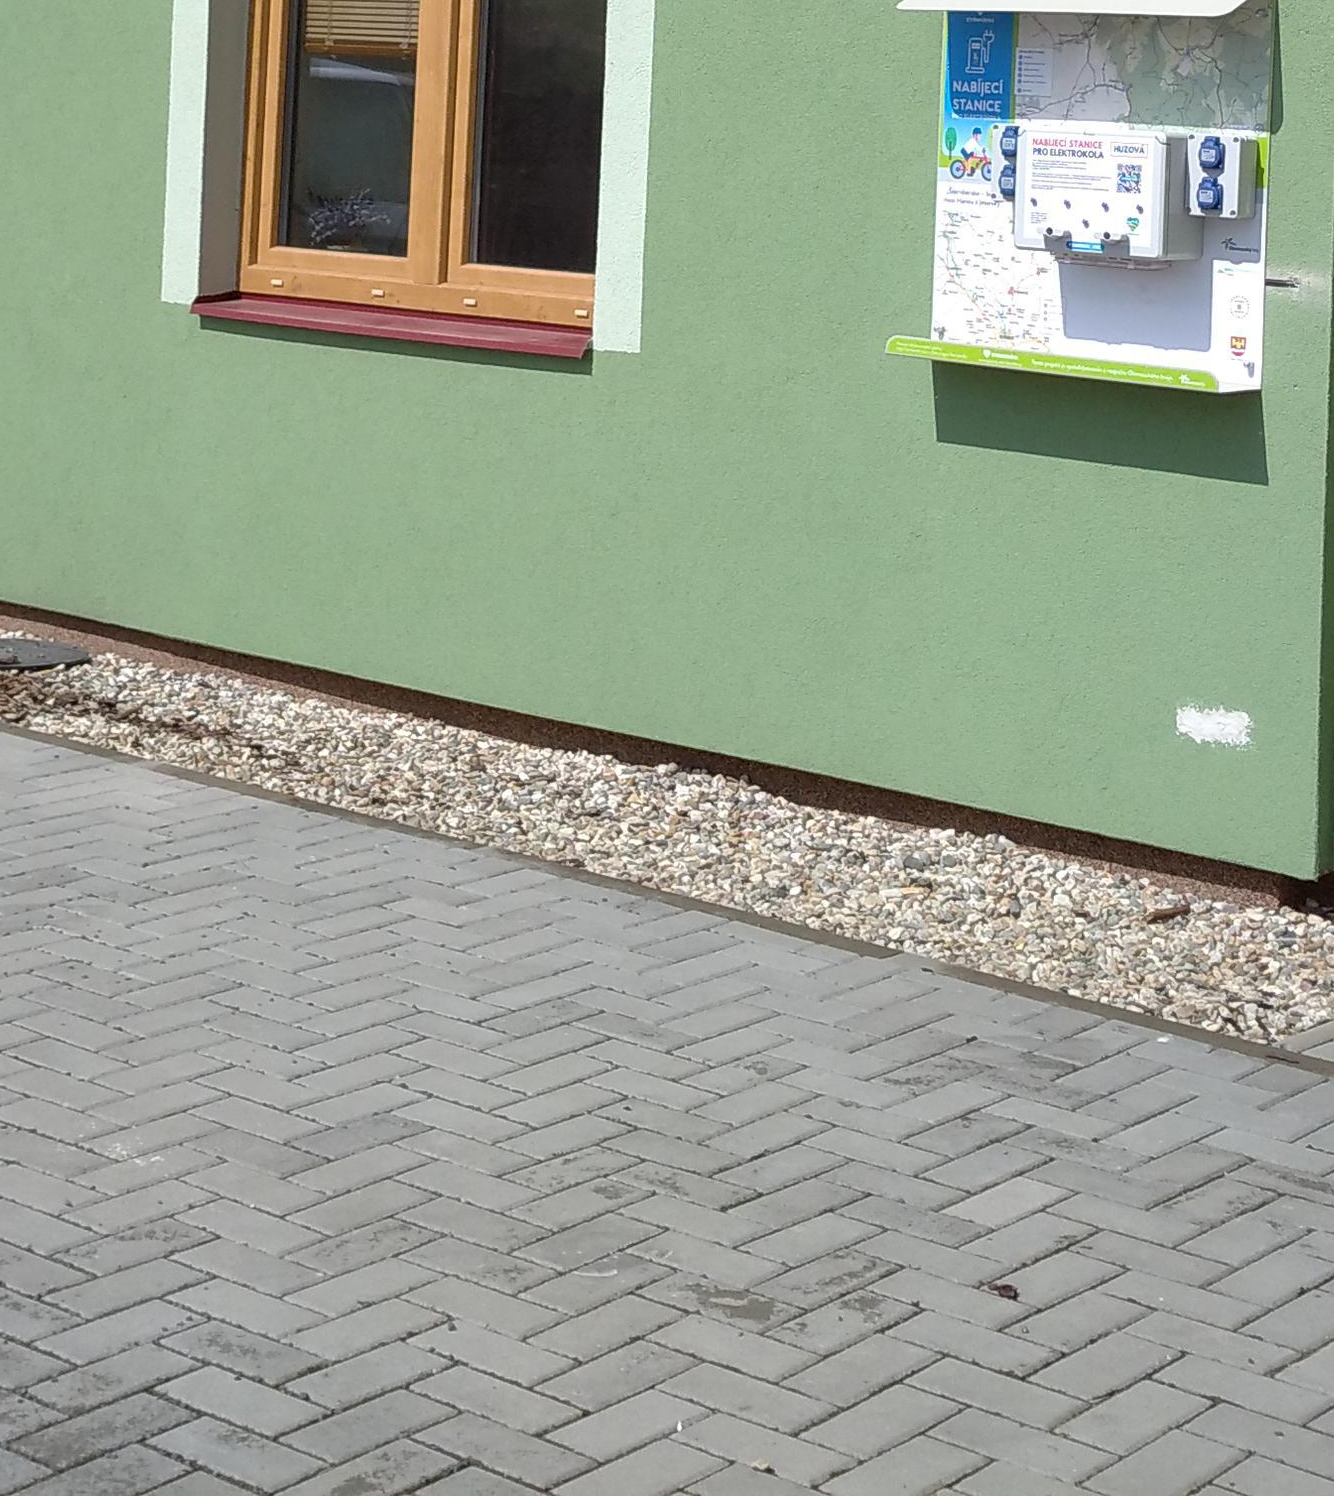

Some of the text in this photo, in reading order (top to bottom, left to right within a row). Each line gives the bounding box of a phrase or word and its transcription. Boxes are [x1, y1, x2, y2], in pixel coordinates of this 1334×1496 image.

[952, 78, 1004, 98] NABÍJECÍ
[952, 98, 1002, 112] STANICE
[1069, 139, 1103, 150] STANICE
[1113, 143, 1145, 154] HUZOVÁ
[1032, 147, 1105, 159] PRO ELEKTROKOLA
